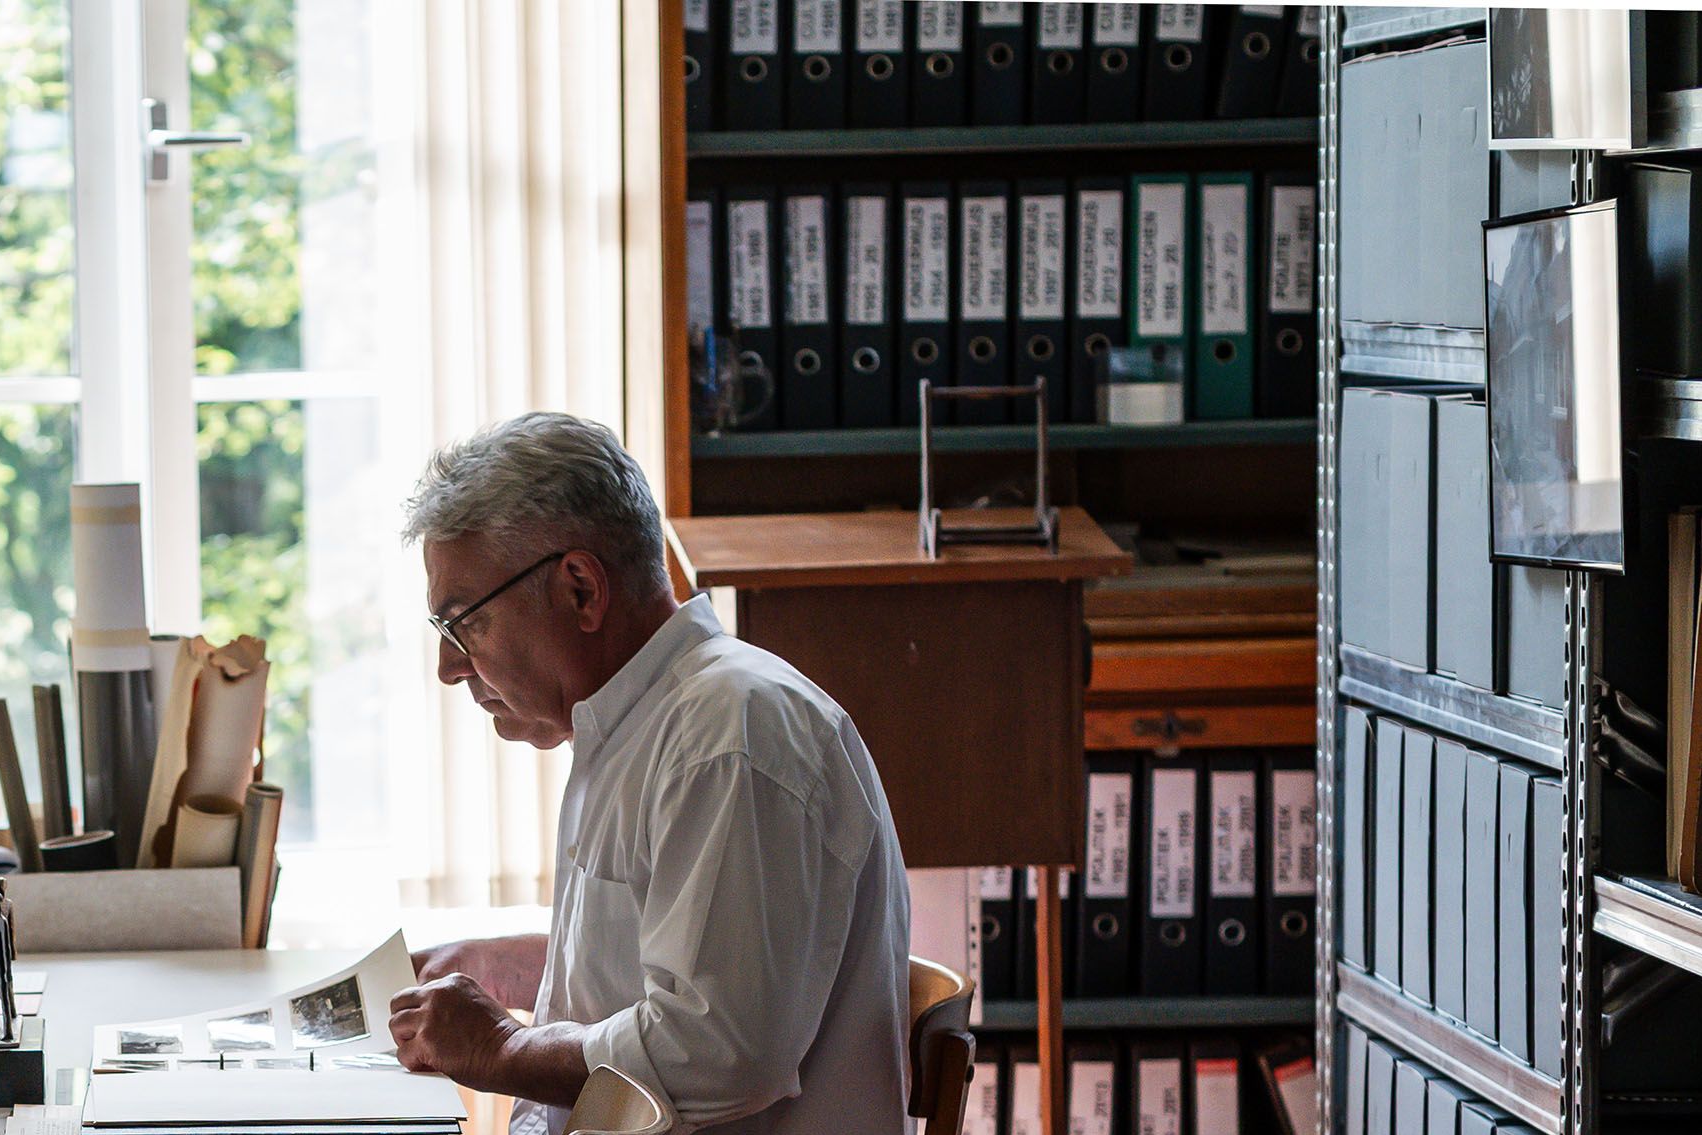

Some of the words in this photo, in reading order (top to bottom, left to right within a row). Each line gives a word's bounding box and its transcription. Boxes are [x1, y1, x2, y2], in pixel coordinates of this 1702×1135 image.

[908, 205, 925, 309] ONDERWIJS
[966, 203, 985, 308] ONDERWIJS
[1022, 202, 1041, 308] ONDERWIJS
[1082, 199, 1100, 306] ONDERWIJS
[1089, 805, 1107, 885] POLITIEK
[1154, 823, 1172, 905] POLITIEK
[1277, 802, 1293, 883] POLITIEK
